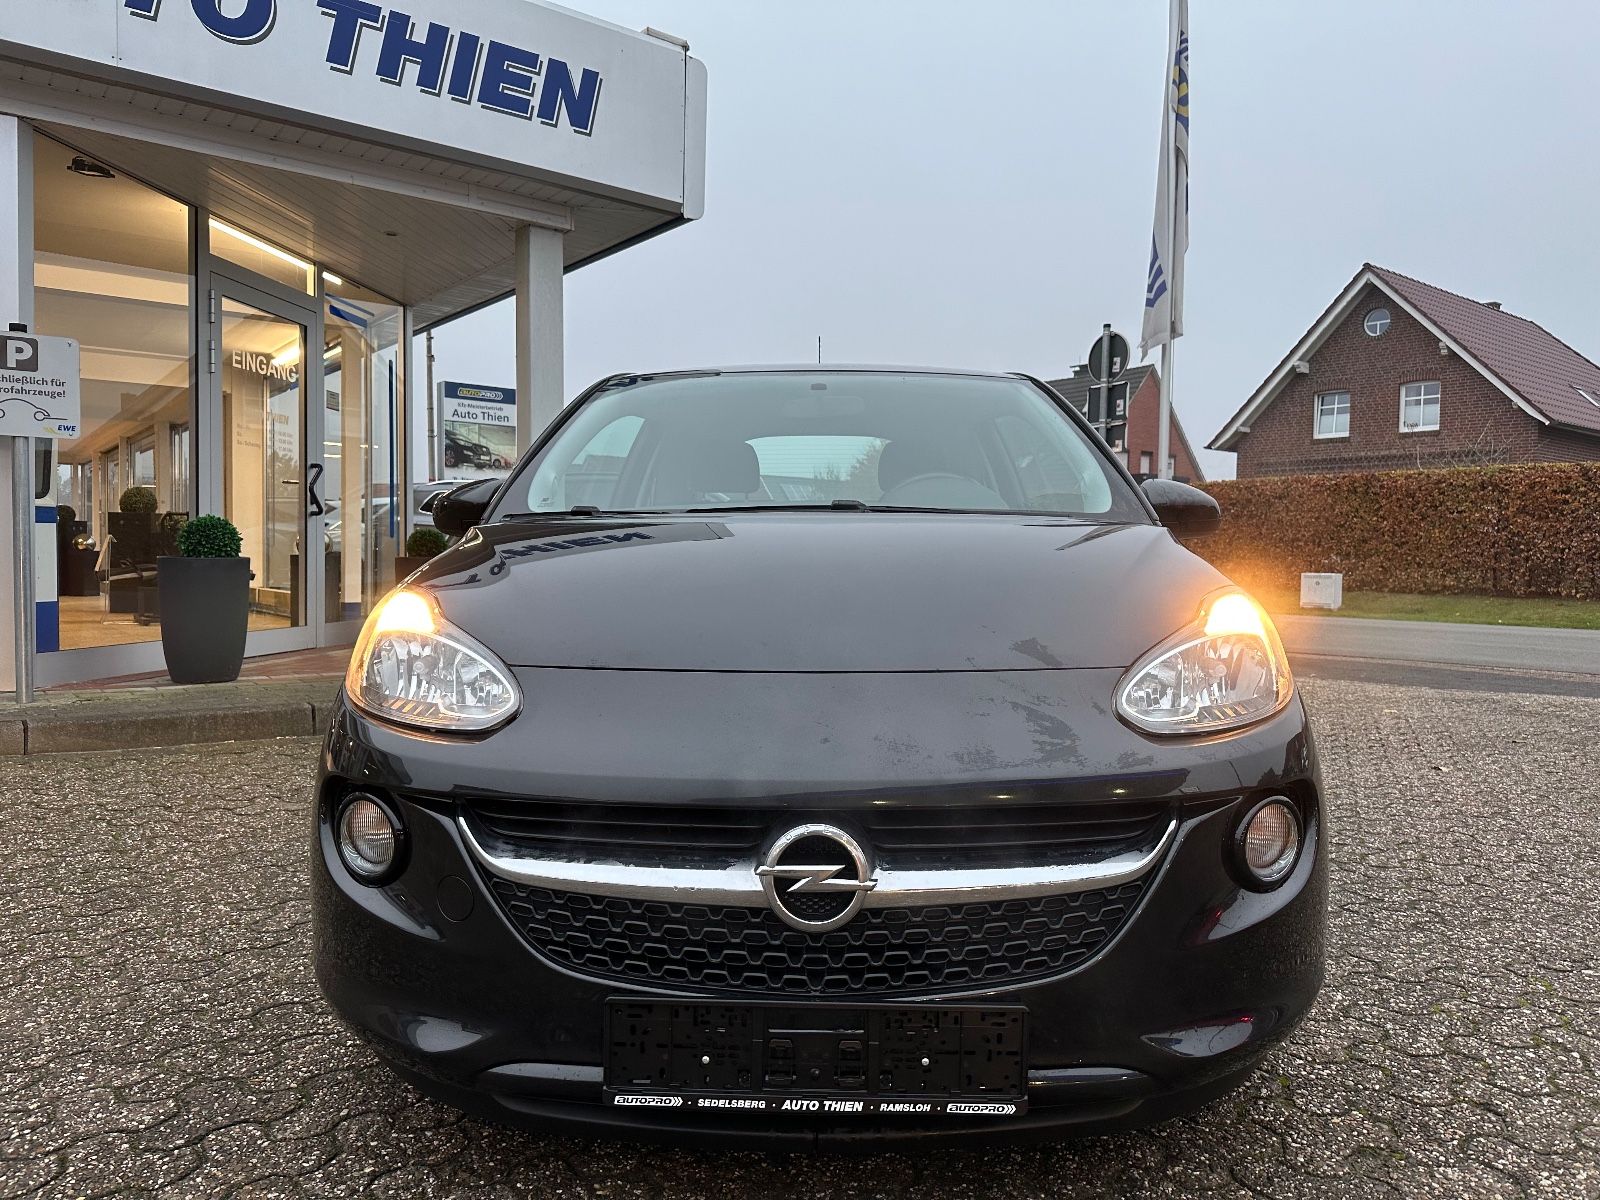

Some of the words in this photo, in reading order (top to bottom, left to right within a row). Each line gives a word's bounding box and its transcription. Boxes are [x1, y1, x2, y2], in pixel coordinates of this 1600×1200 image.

[317, 0, 602, 137] THIEN
[7, 340, 33, 368] P
[232, 350, 296, 382] EINGANG
[0, 374, 48, 385] hließlich
[50, 378, 66, 387] für
[452, 408, 478, 420] Auto
[480, 411, 510, 423] Thien
[58, 424, 76, 432] EWE
[698, 1098, 766, 1109] SEDELSBERG
[781, 1099, 820, 1111] AUTO
[823, 1101, 864, 1112] THIEN
[880, 1103, 931, 1112] RAMSLOH
